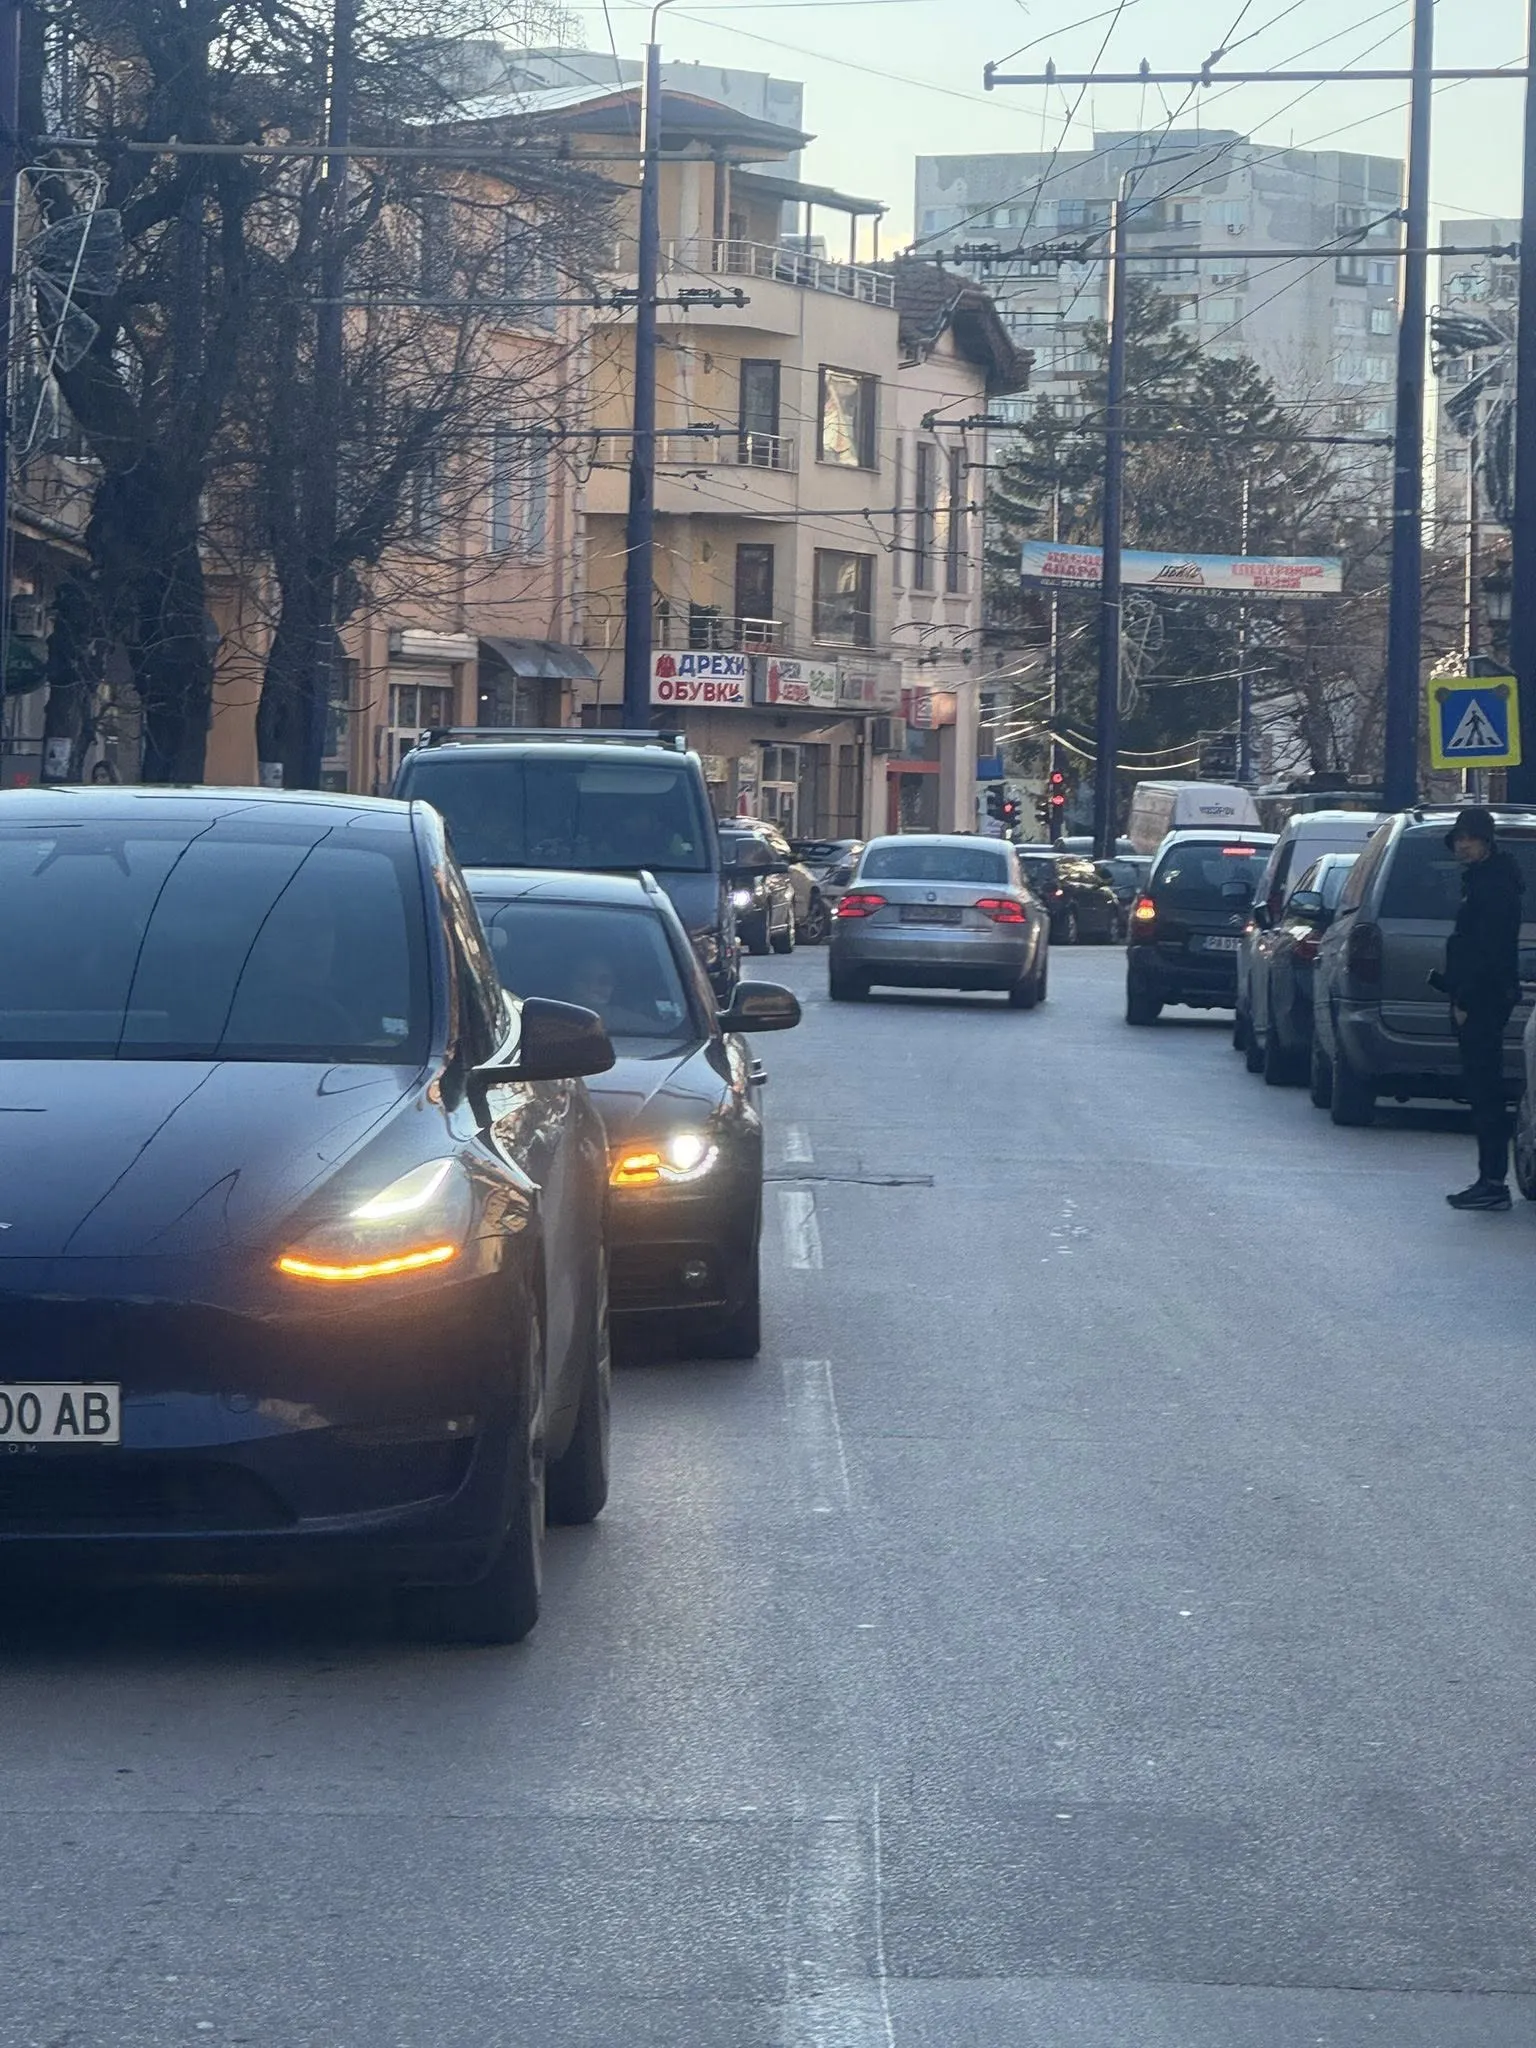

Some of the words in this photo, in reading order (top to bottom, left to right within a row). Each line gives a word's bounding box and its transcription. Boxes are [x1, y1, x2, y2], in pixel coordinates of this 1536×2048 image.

[679, 654, 745, 677] ДРЕХИ
[658, 681, 741, 702] ОБУВКИ
[53, 1392, 111, 1435] AB
